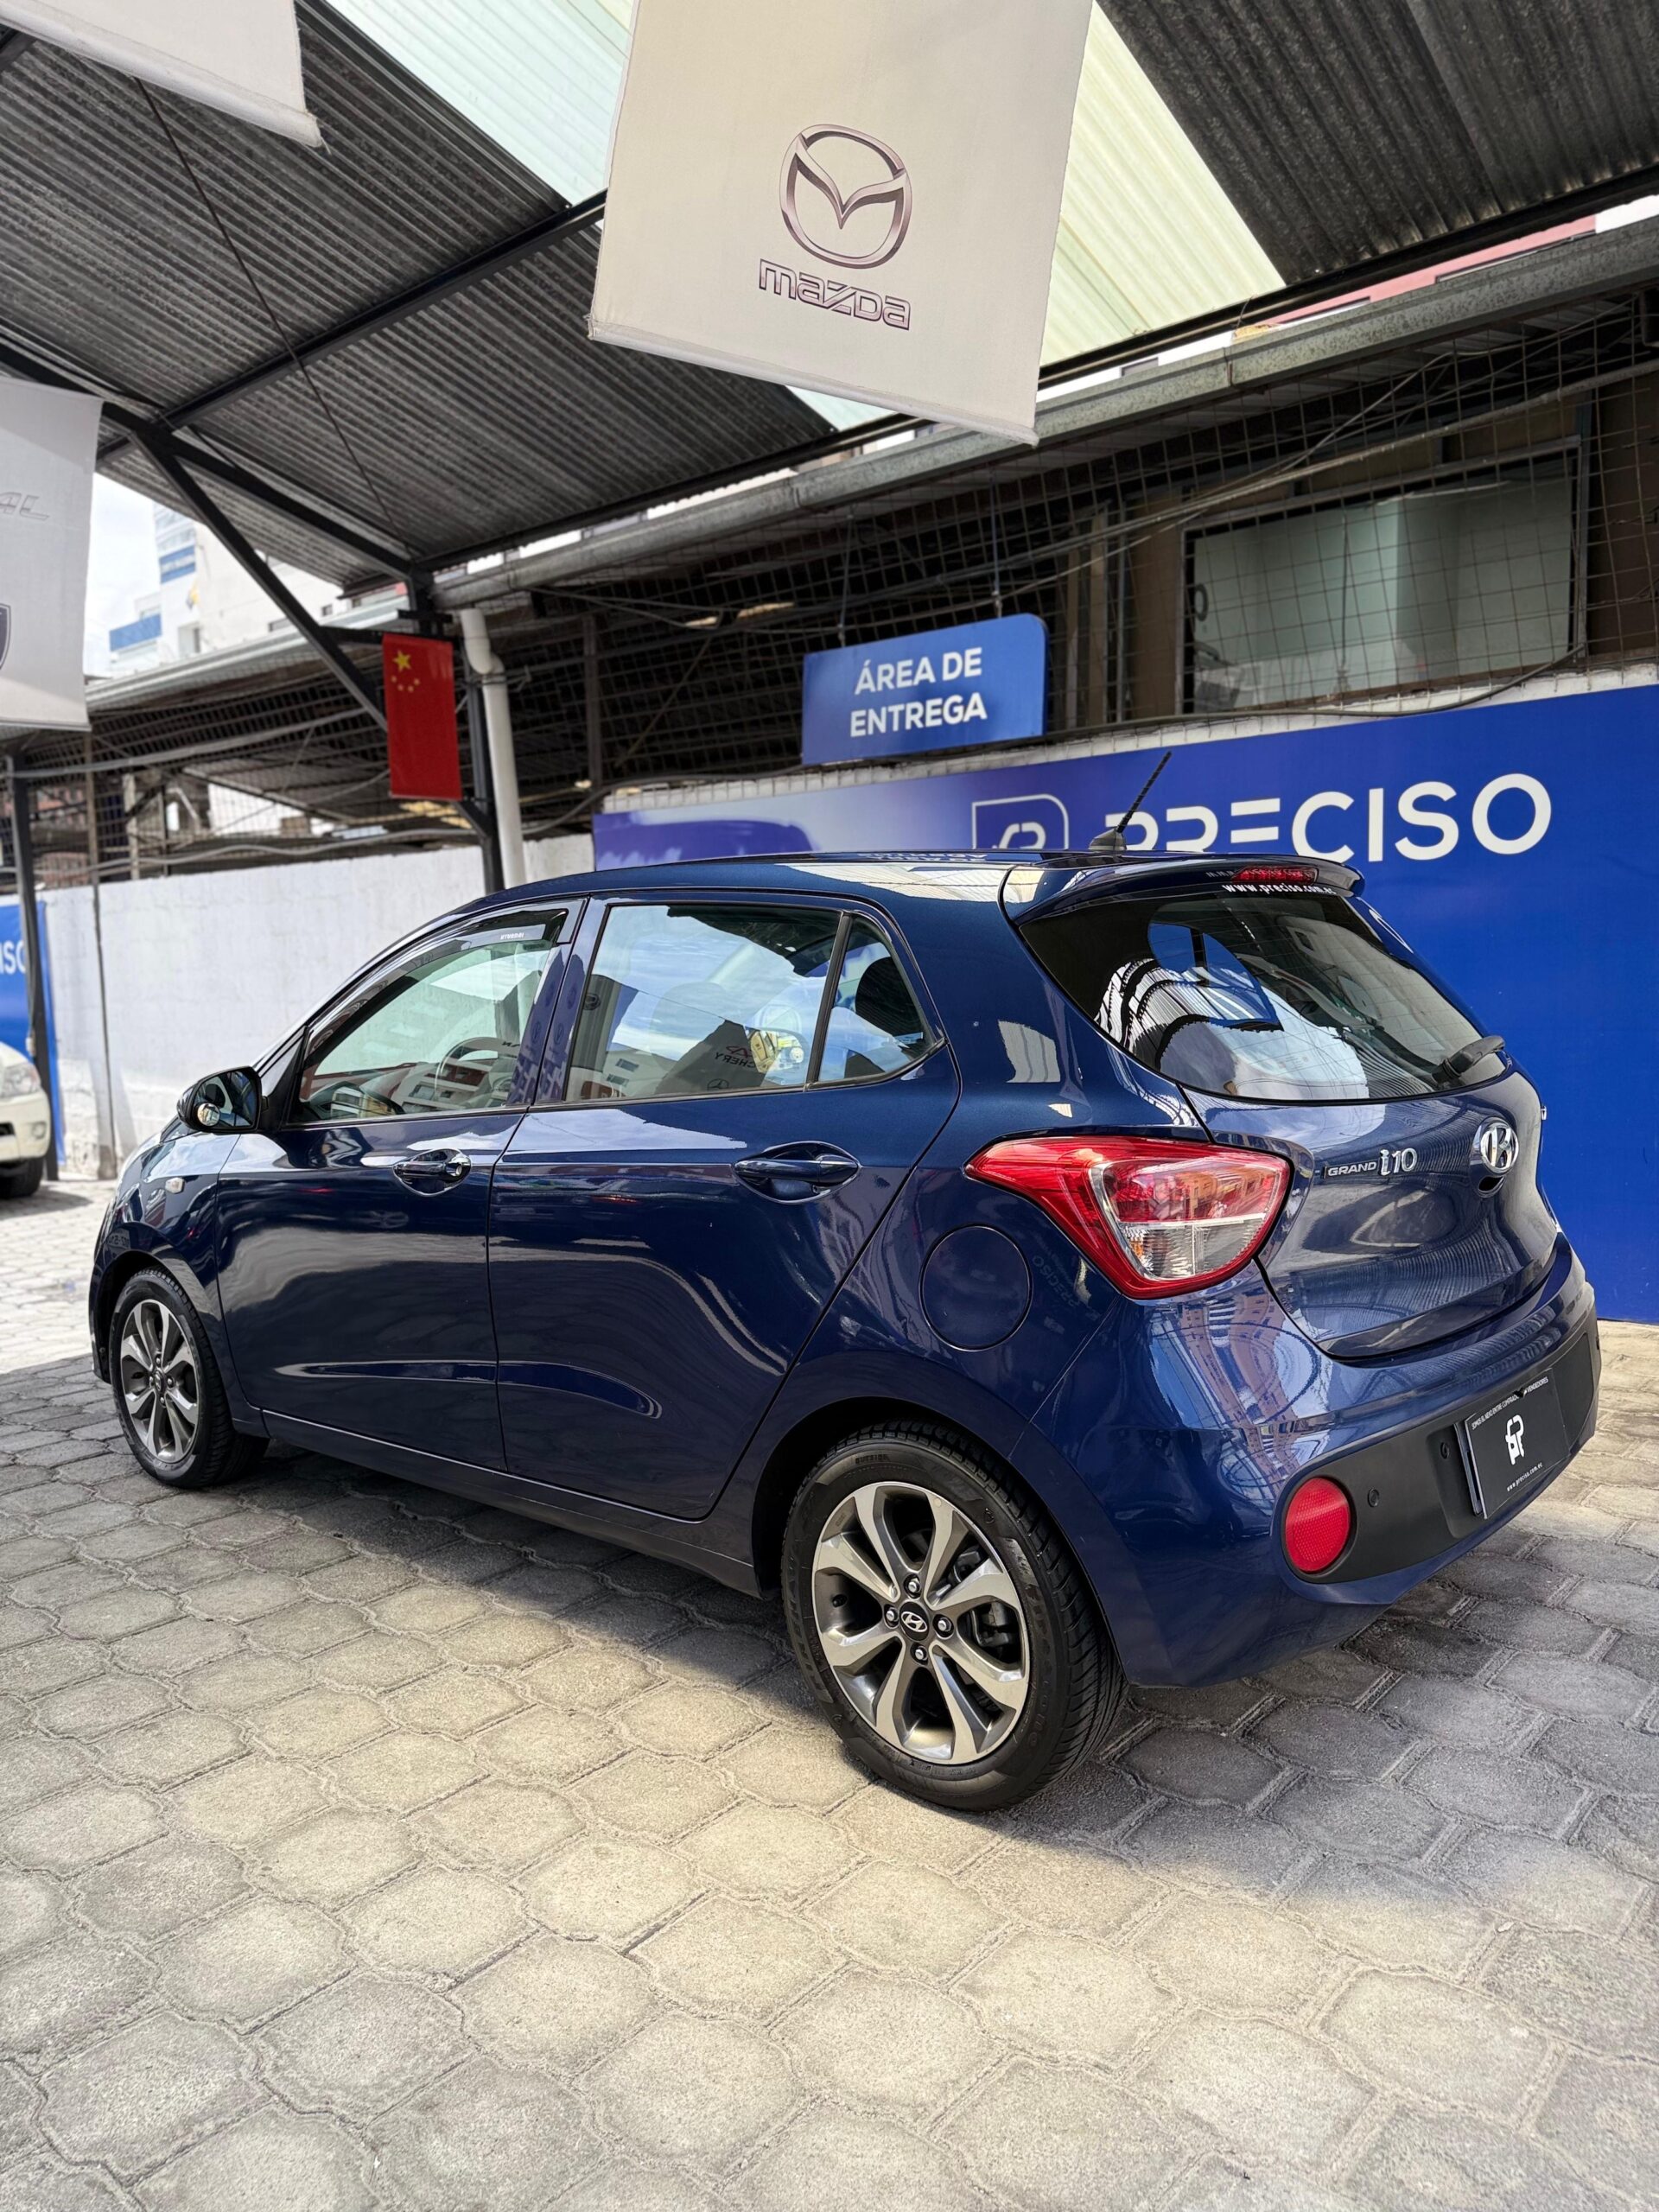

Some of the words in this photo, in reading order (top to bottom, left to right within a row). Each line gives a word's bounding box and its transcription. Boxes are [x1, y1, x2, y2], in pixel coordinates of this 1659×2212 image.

[759, 258, 912, 332] mazda
[854, 657, 936, 696] ÁREA
[943, 647, 982, 681] DE
[850, 691, 988, 738] ENTREGA
[1104, 773, 1552, 862] PRECISO
[1222, 882, 1338, 895] www.preciso.com.ec
[1327, 1162, 1377, 1176] GRAND
[1380, 1148, 1417, 1176] i10
